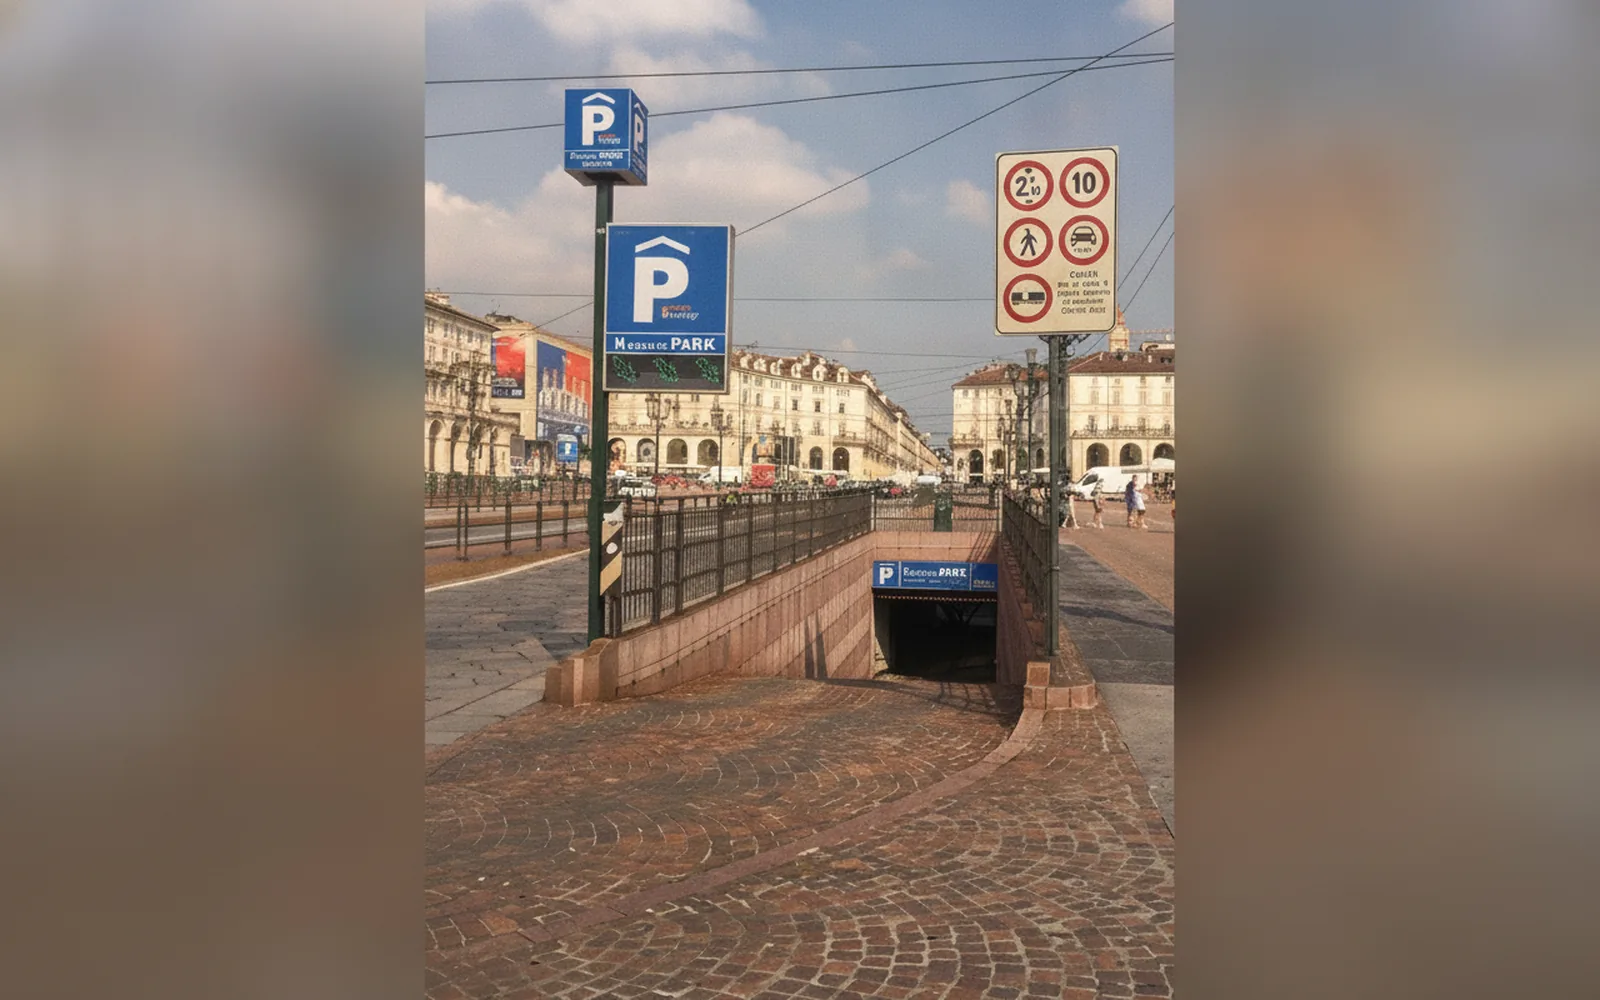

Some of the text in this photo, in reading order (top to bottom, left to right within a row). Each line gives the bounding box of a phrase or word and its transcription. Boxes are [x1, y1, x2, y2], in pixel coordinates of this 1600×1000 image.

[582, 105, 615, 146] P
[1072, 171, 1096, 194] 10
[633, 257, 689, 323] P
[670, 336, 716, 351] PARK
[879, 566, 894, 585] P
